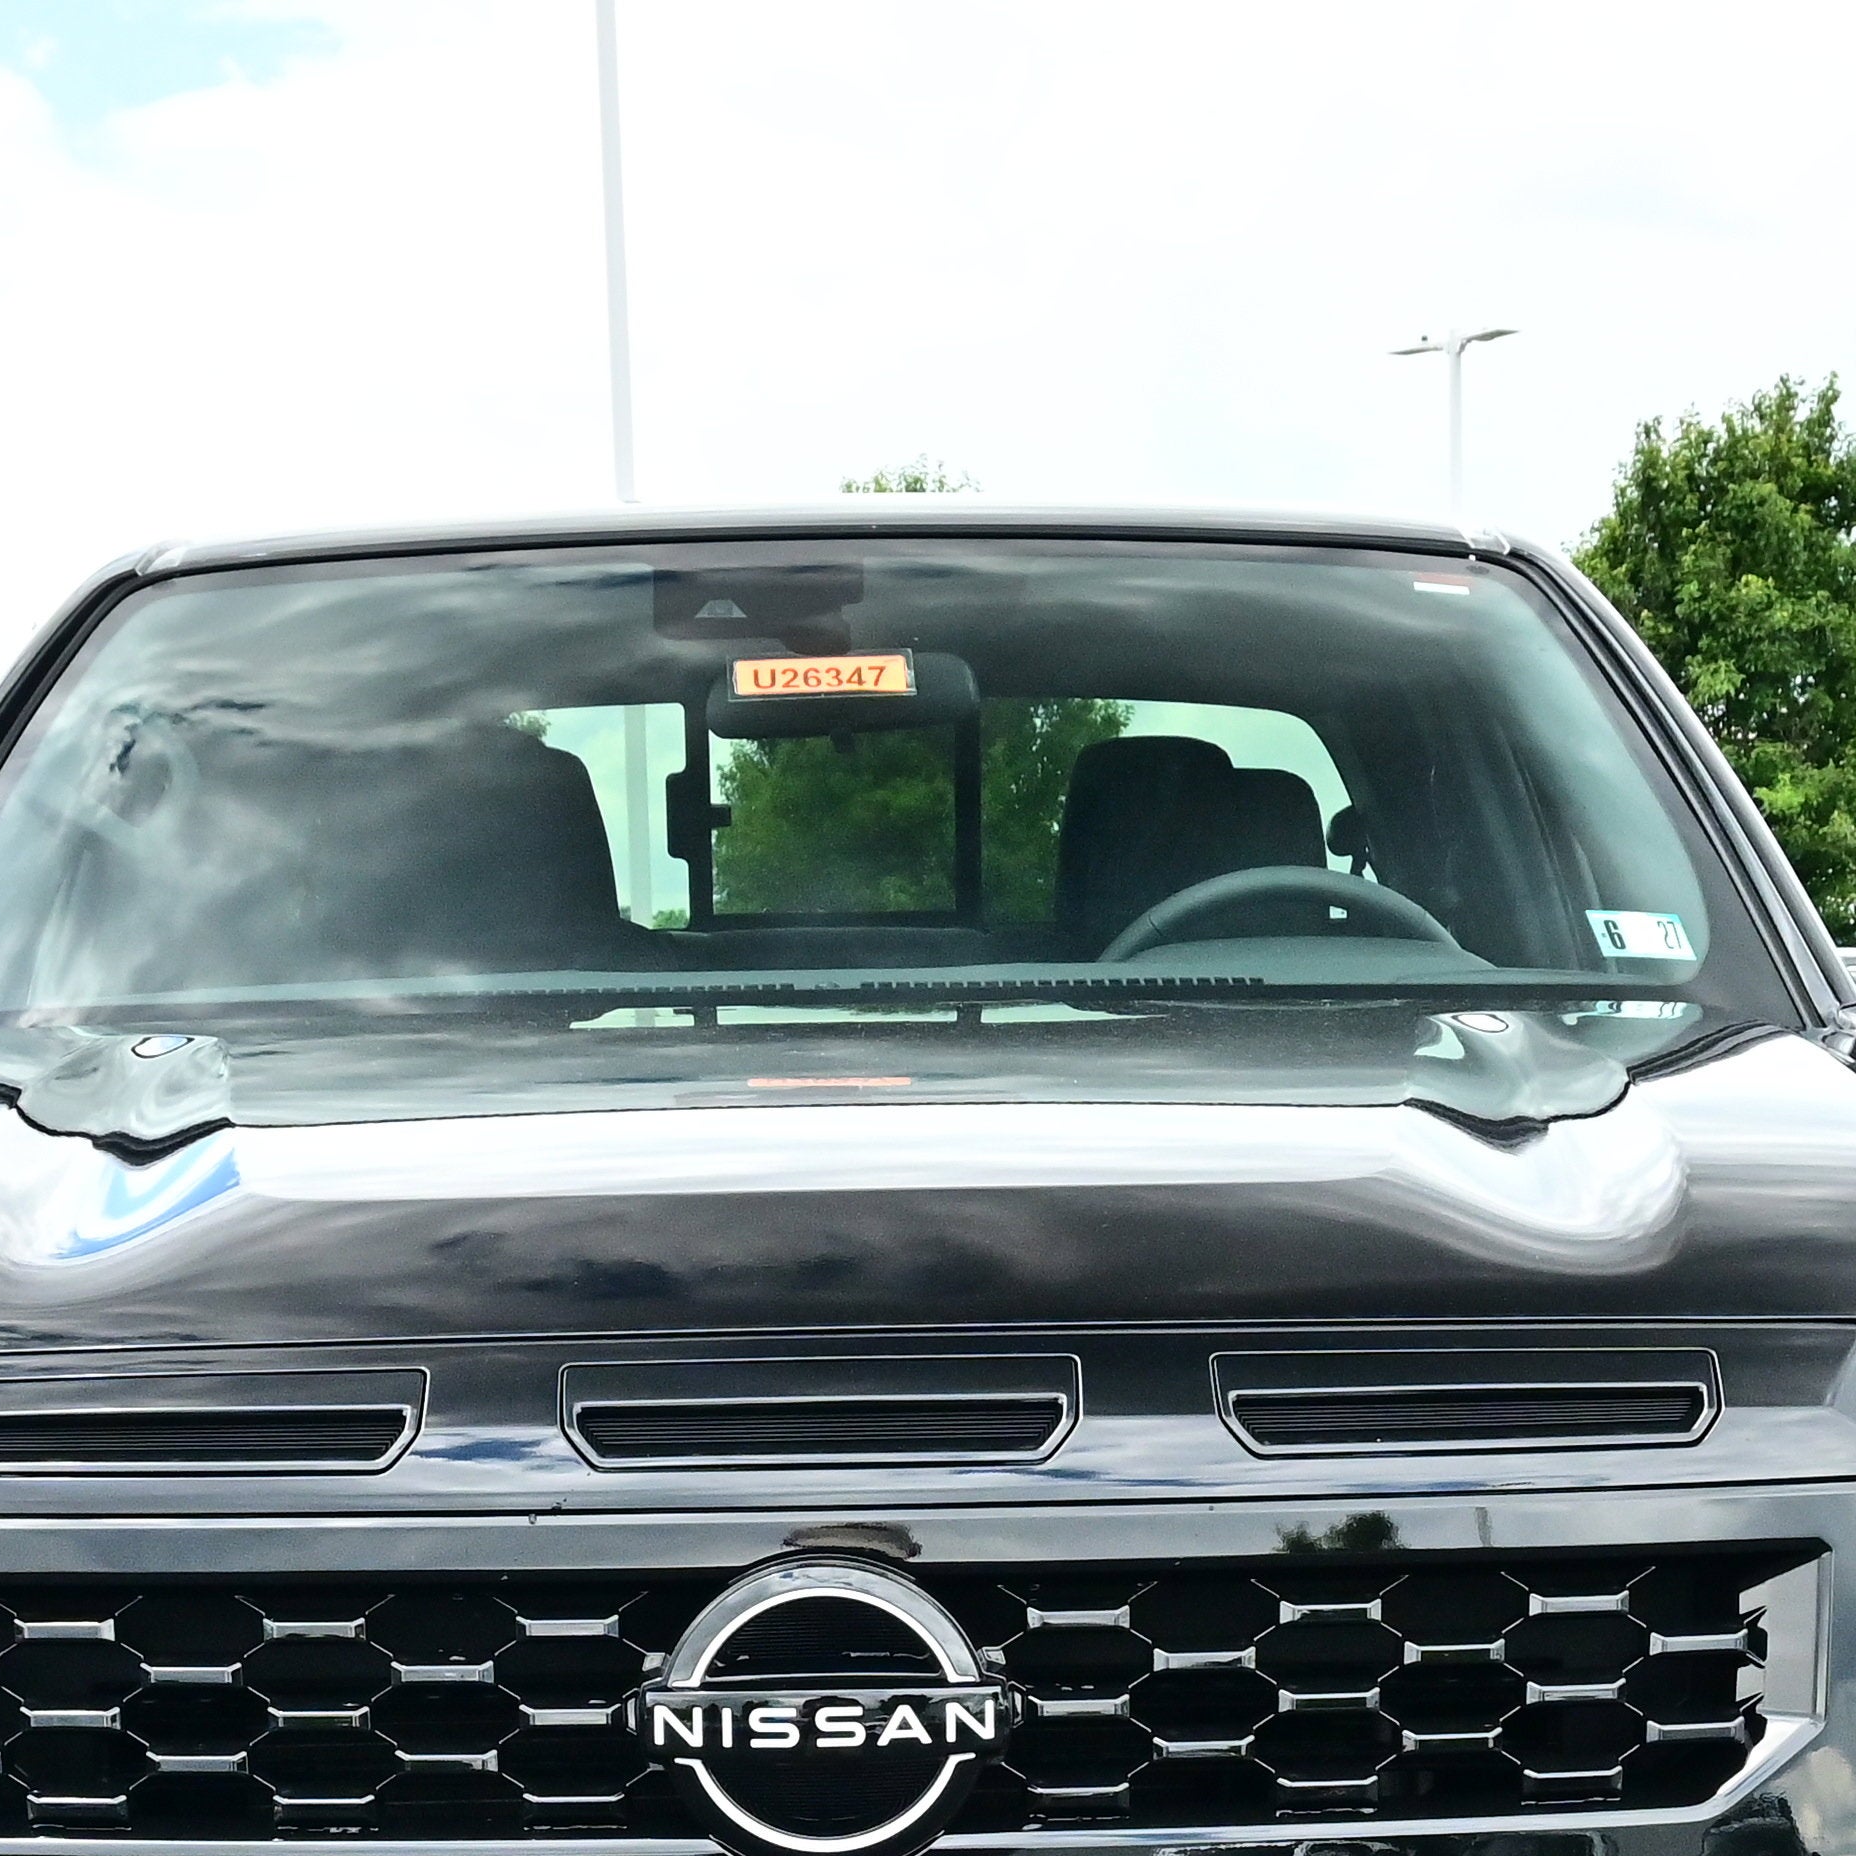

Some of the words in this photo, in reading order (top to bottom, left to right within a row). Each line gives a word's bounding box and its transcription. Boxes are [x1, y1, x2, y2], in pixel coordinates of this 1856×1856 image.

[753, 665, 887, 689] U26347
[1603, 919, 1627, 950] 6
[652, 1698, 996, 1749] NISSAN
